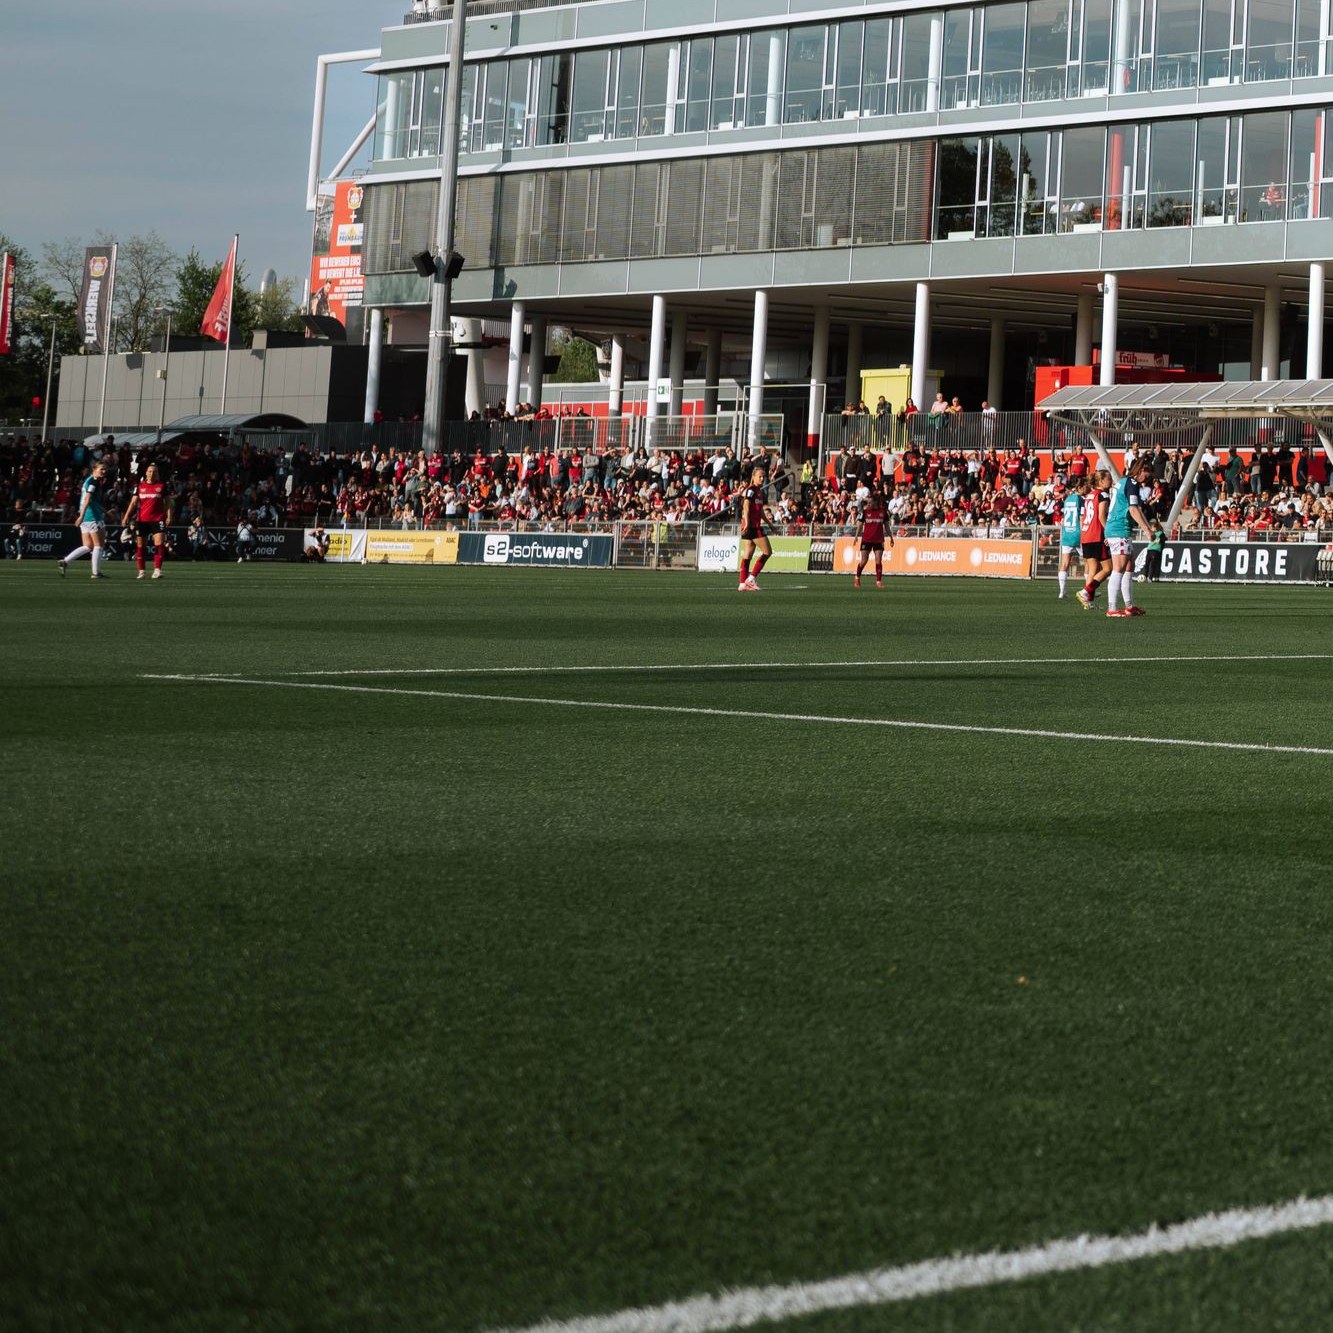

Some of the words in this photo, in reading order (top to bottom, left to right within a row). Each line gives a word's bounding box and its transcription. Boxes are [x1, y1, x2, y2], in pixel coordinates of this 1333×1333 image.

[1119, 352, 1138, 366] früh
[1063, 507, 1077, 527] 27
[704, 547, 731, 562] reloga
[918, 551, 957, 562] LEDVANCE
[984, 552, 1023, 564] LEDVANCE
[1160, 547, 1288, 576] CASTORE
